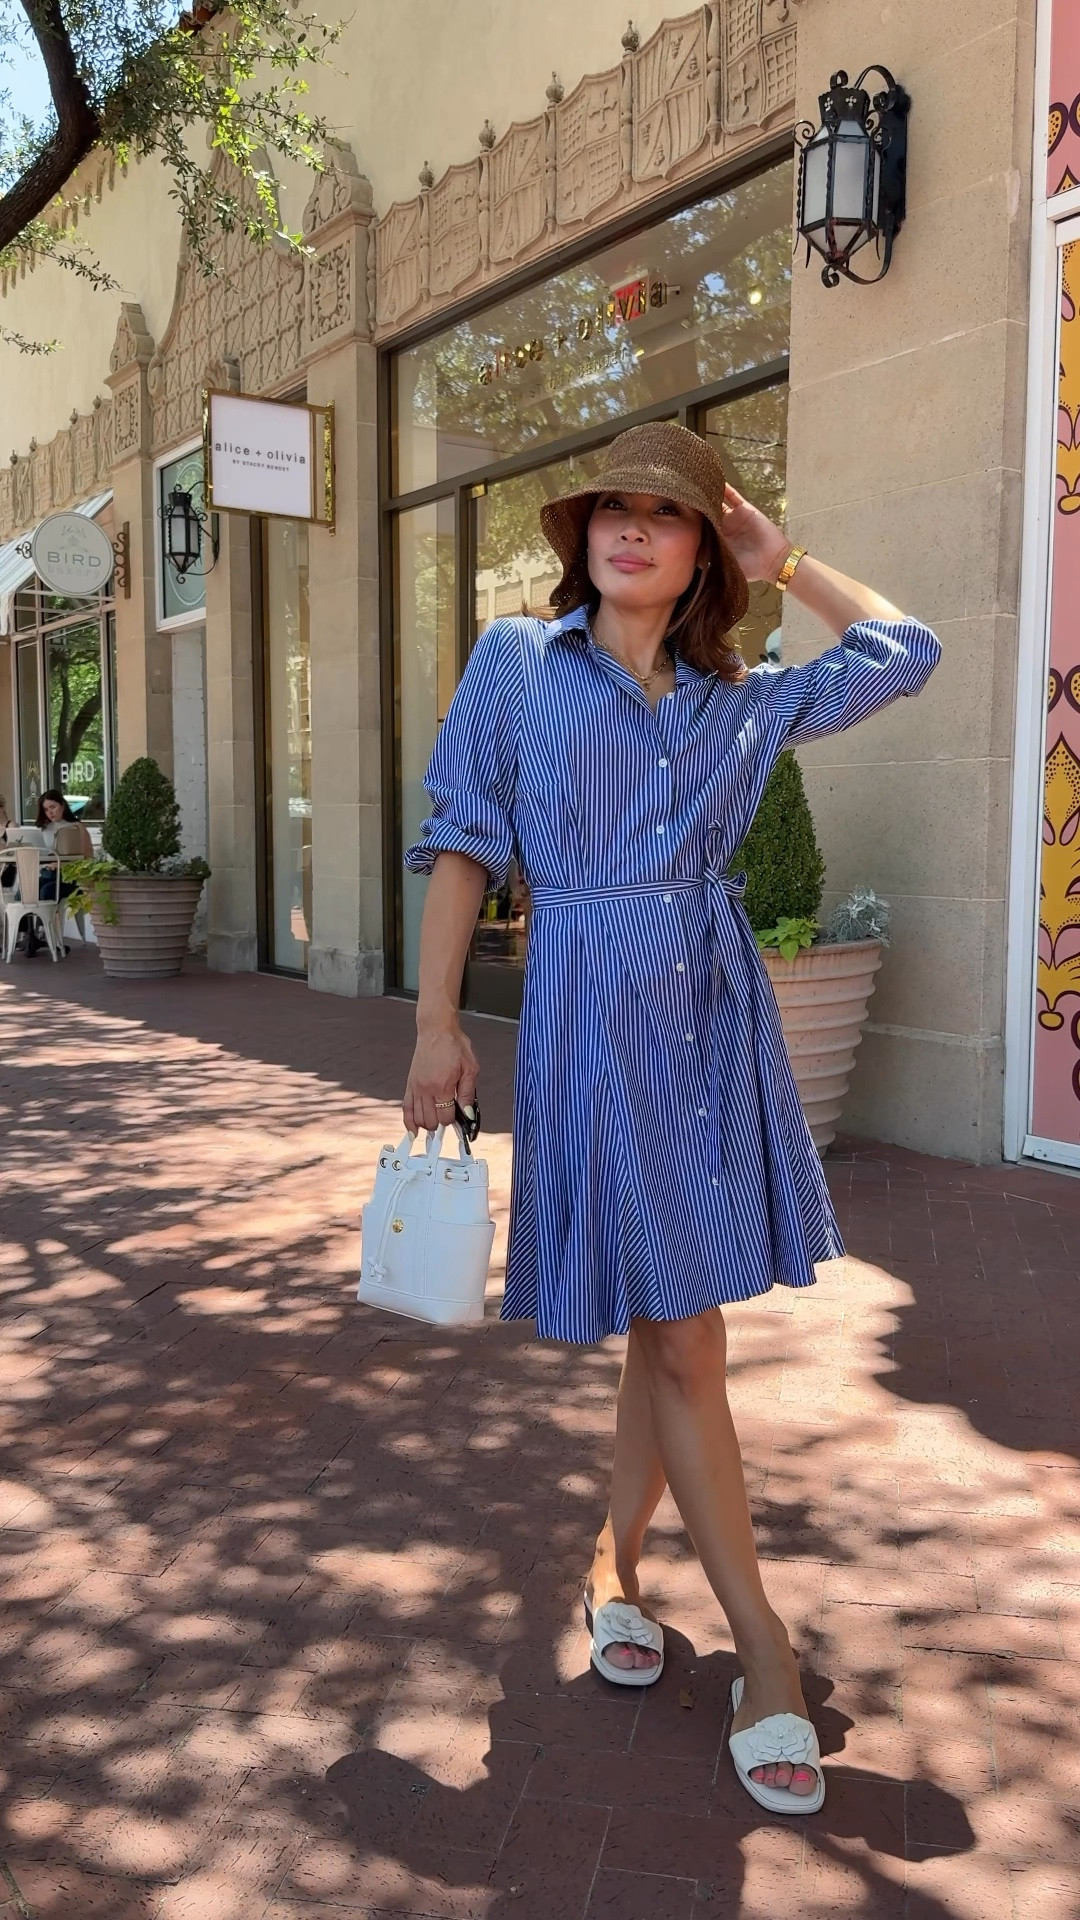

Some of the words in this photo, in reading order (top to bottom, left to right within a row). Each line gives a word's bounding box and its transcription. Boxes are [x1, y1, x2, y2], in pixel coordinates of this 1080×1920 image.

[478, 337, 544, 386] alice
[575, 280, 668, 342] olivia
[215, 442, 250, 456] alice
[255, 449, 262, 457] +
[266, 450, 306, 464] olivia
[47, 551, 101, 568] BIRD
[60, 760, 95, 784] BIRD
